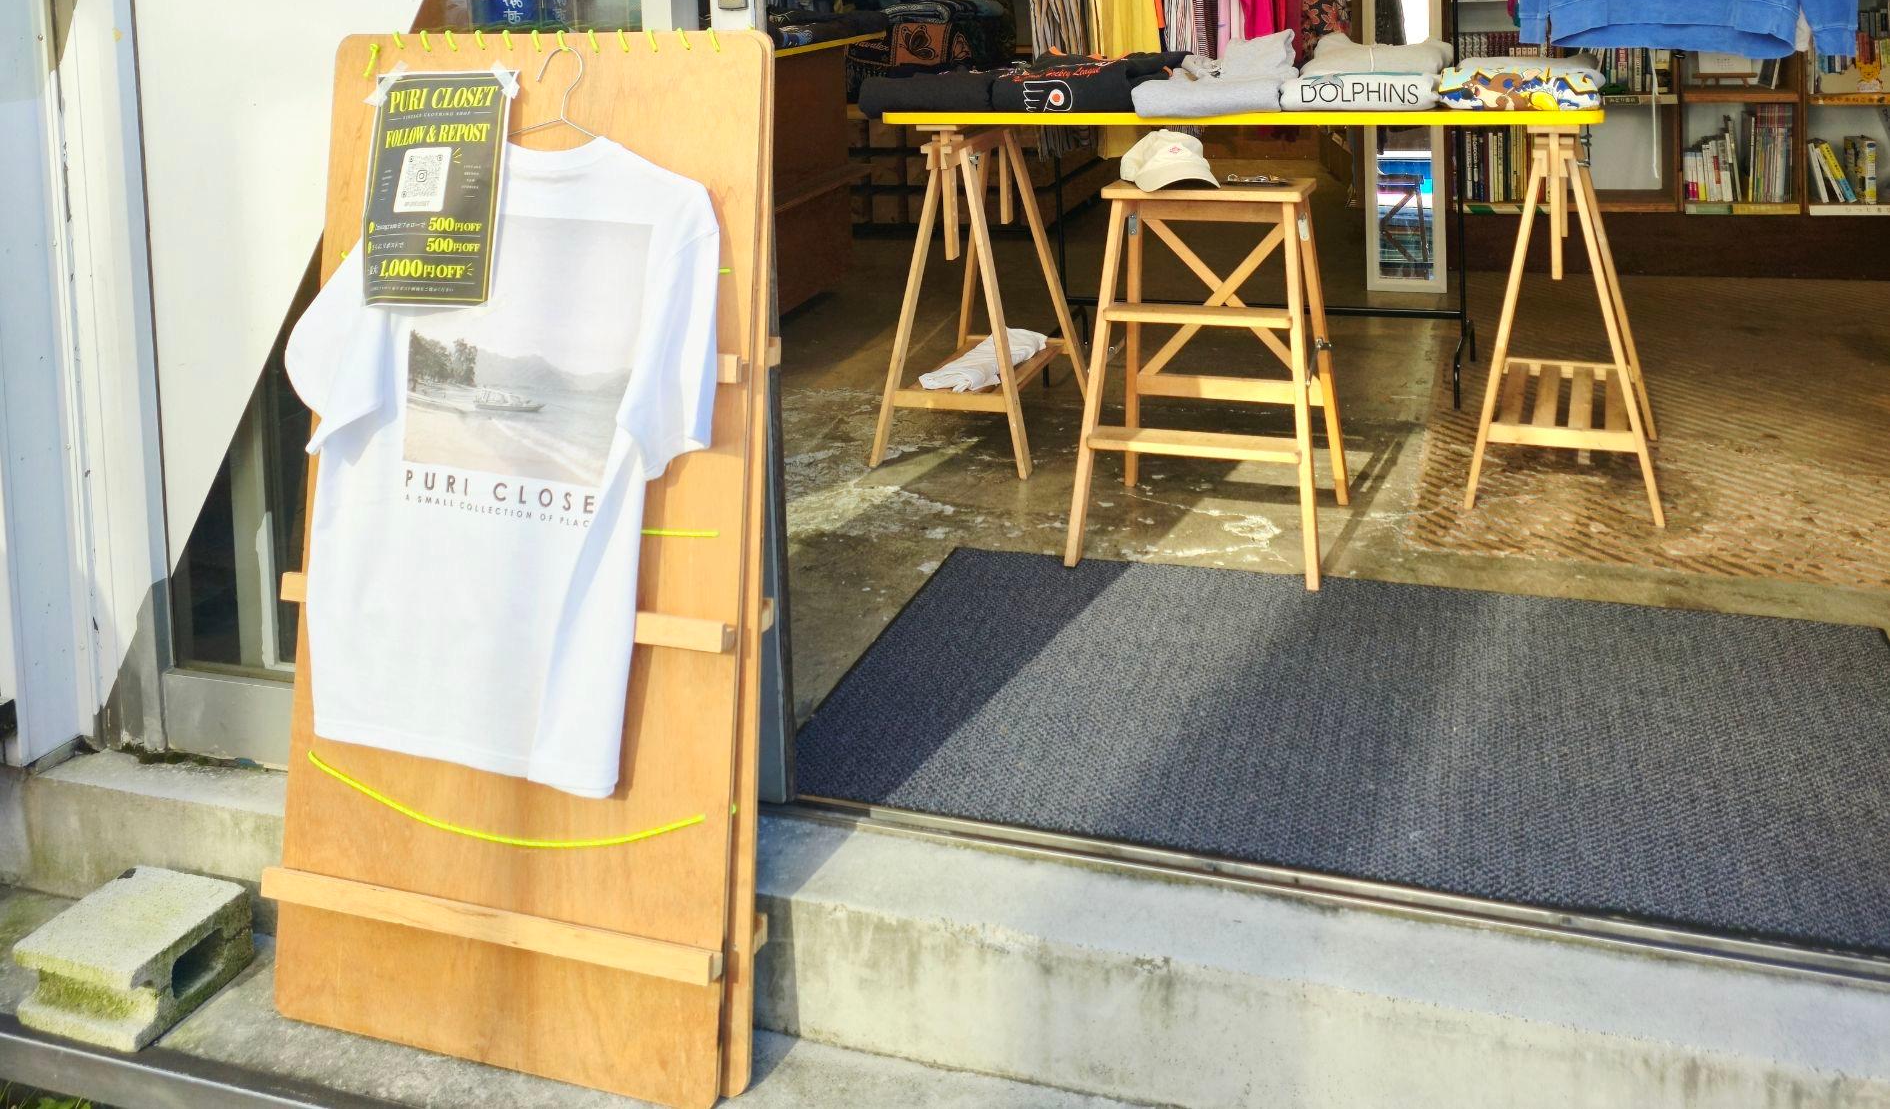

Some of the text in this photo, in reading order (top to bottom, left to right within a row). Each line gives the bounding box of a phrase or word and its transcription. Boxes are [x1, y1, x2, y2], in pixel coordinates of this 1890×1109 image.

[389, 85, 499, 113] PURI CLOSET
[1301, 82, 1419, 104] DOLPHINS
[385, 123, 490, 149] FOLLOW & REPOST
[405, 470, 595, 514] PURI CLOSE
[417, 495, 455, 507] SMALL
[459, 502, 532, 519] COLLECTION
[540, 513, 553, 523] OF
